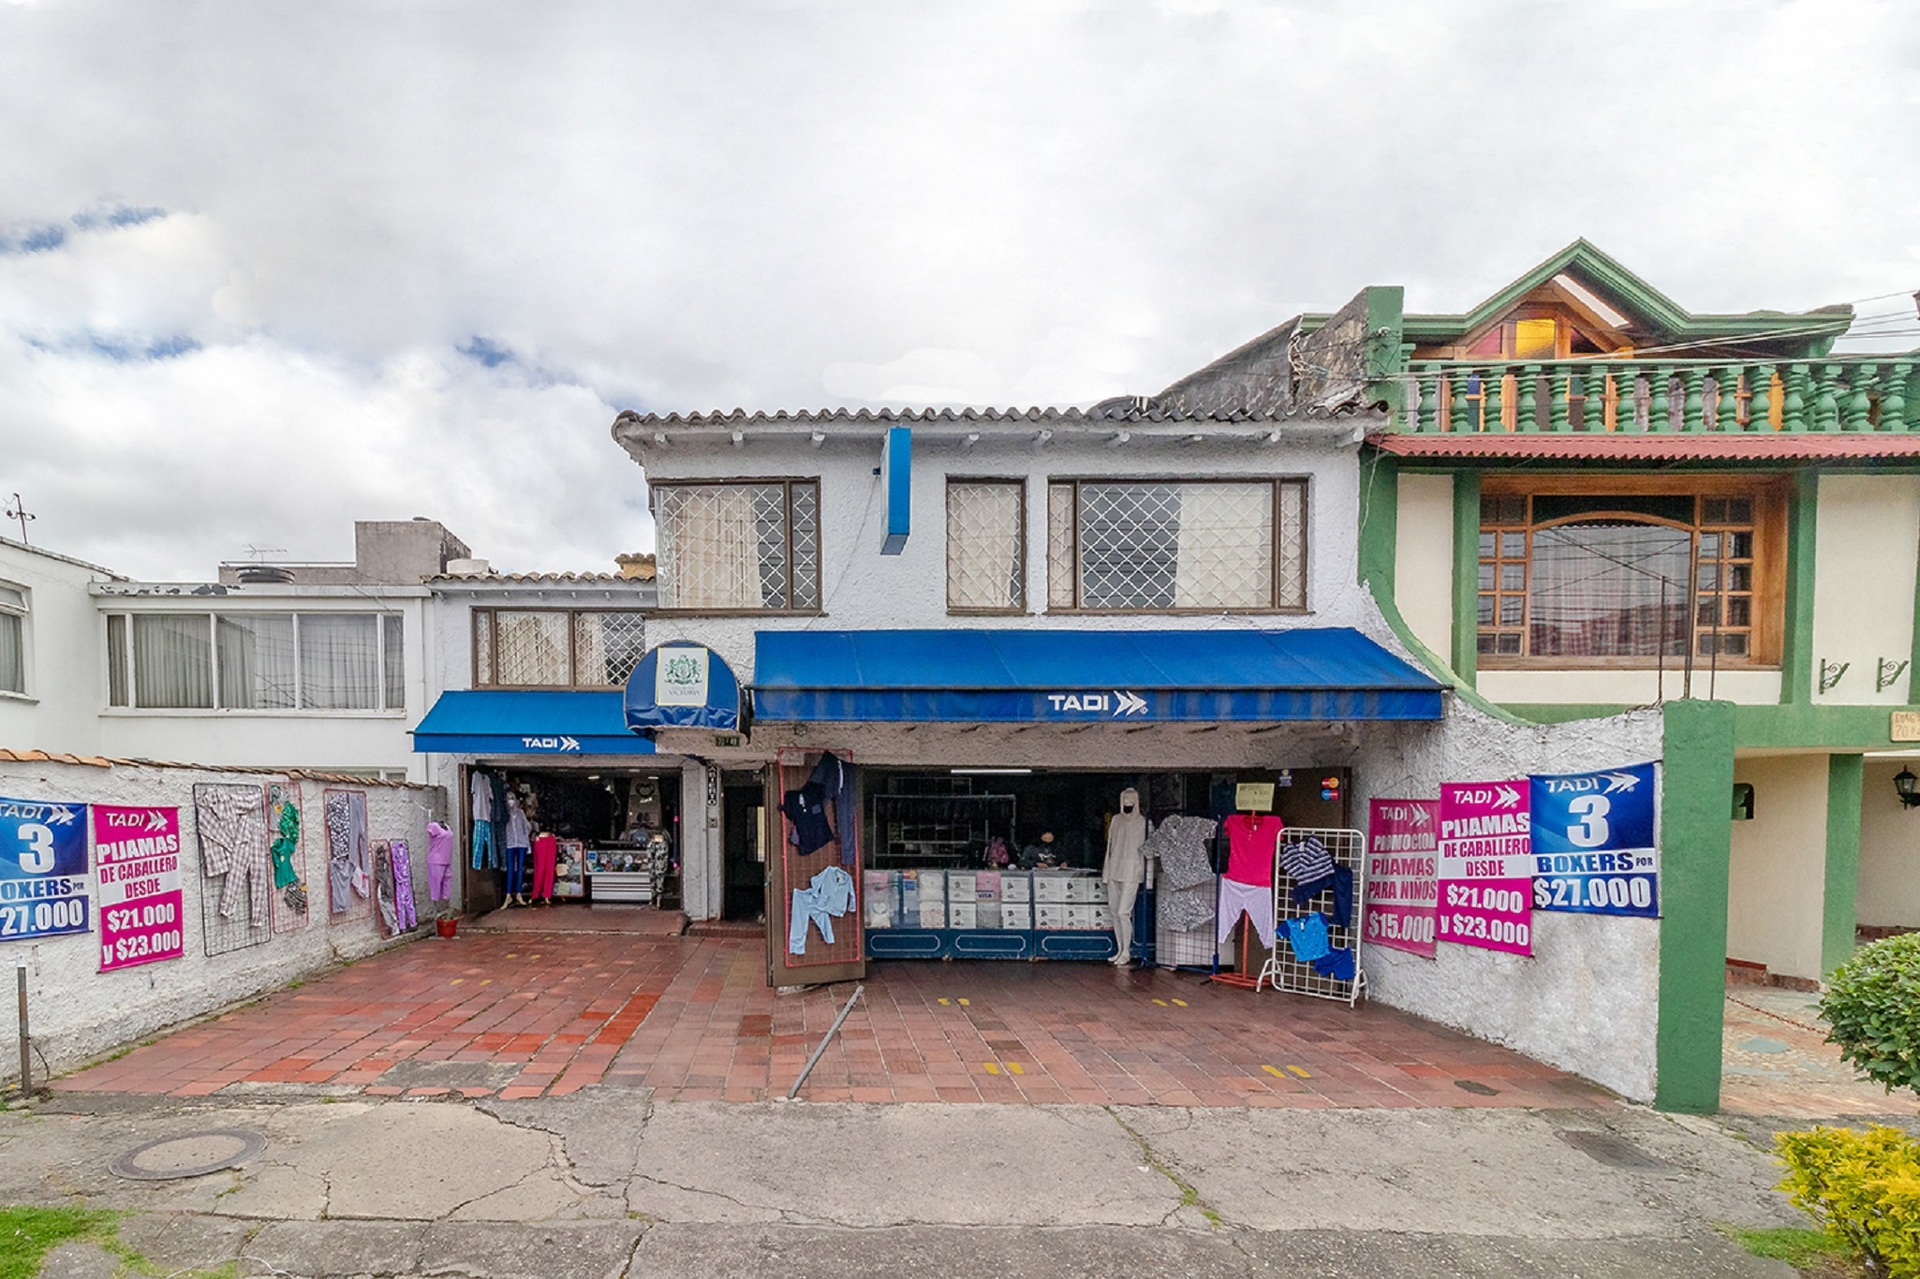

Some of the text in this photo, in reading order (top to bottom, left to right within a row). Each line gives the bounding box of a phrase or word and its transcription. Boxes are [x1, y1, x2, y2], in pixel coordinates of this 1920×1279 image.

[1048, 695, 1109, 711] TADI
[522, 738, 558, 748] TADI
[1545, 777, 1600, 793] TADI
[1453, 790, 1492, 804] TADI
[106, 813, 145, 827] TADI
[1380, 807, 1408, 821] TADI
[1441, 812, 1530, 838] PIJAMAS
[1567, 794, 1611, 848] 3
[18, 823, 55, 874] 3
[97, 834, 177, 863] PIJAMAS
[1444, 837, 1530, 858] DE CABALLERO
[100, 855, 178, 884] DE CABALLERO
[1372, 858, 1434, 876] PIJAMAS
[1466, 860, 1504, 877] DESDE
[1537, 852, 1653, 873] BOXERS POR
[125, 878, 161, 899] DESDE
[1368, 877, 1437, 900] PARA NIÑOS
[1447, 883, 1523, 913] $21.000
[1533, 877, 1651, 908] $27.000
[107, 903, 175, 933] $21.000
[1368, 910, 1435, 943] $15.000
[1453, 912, 1529, 946] $23.000
[116, 929, 180, 961] $23.000
